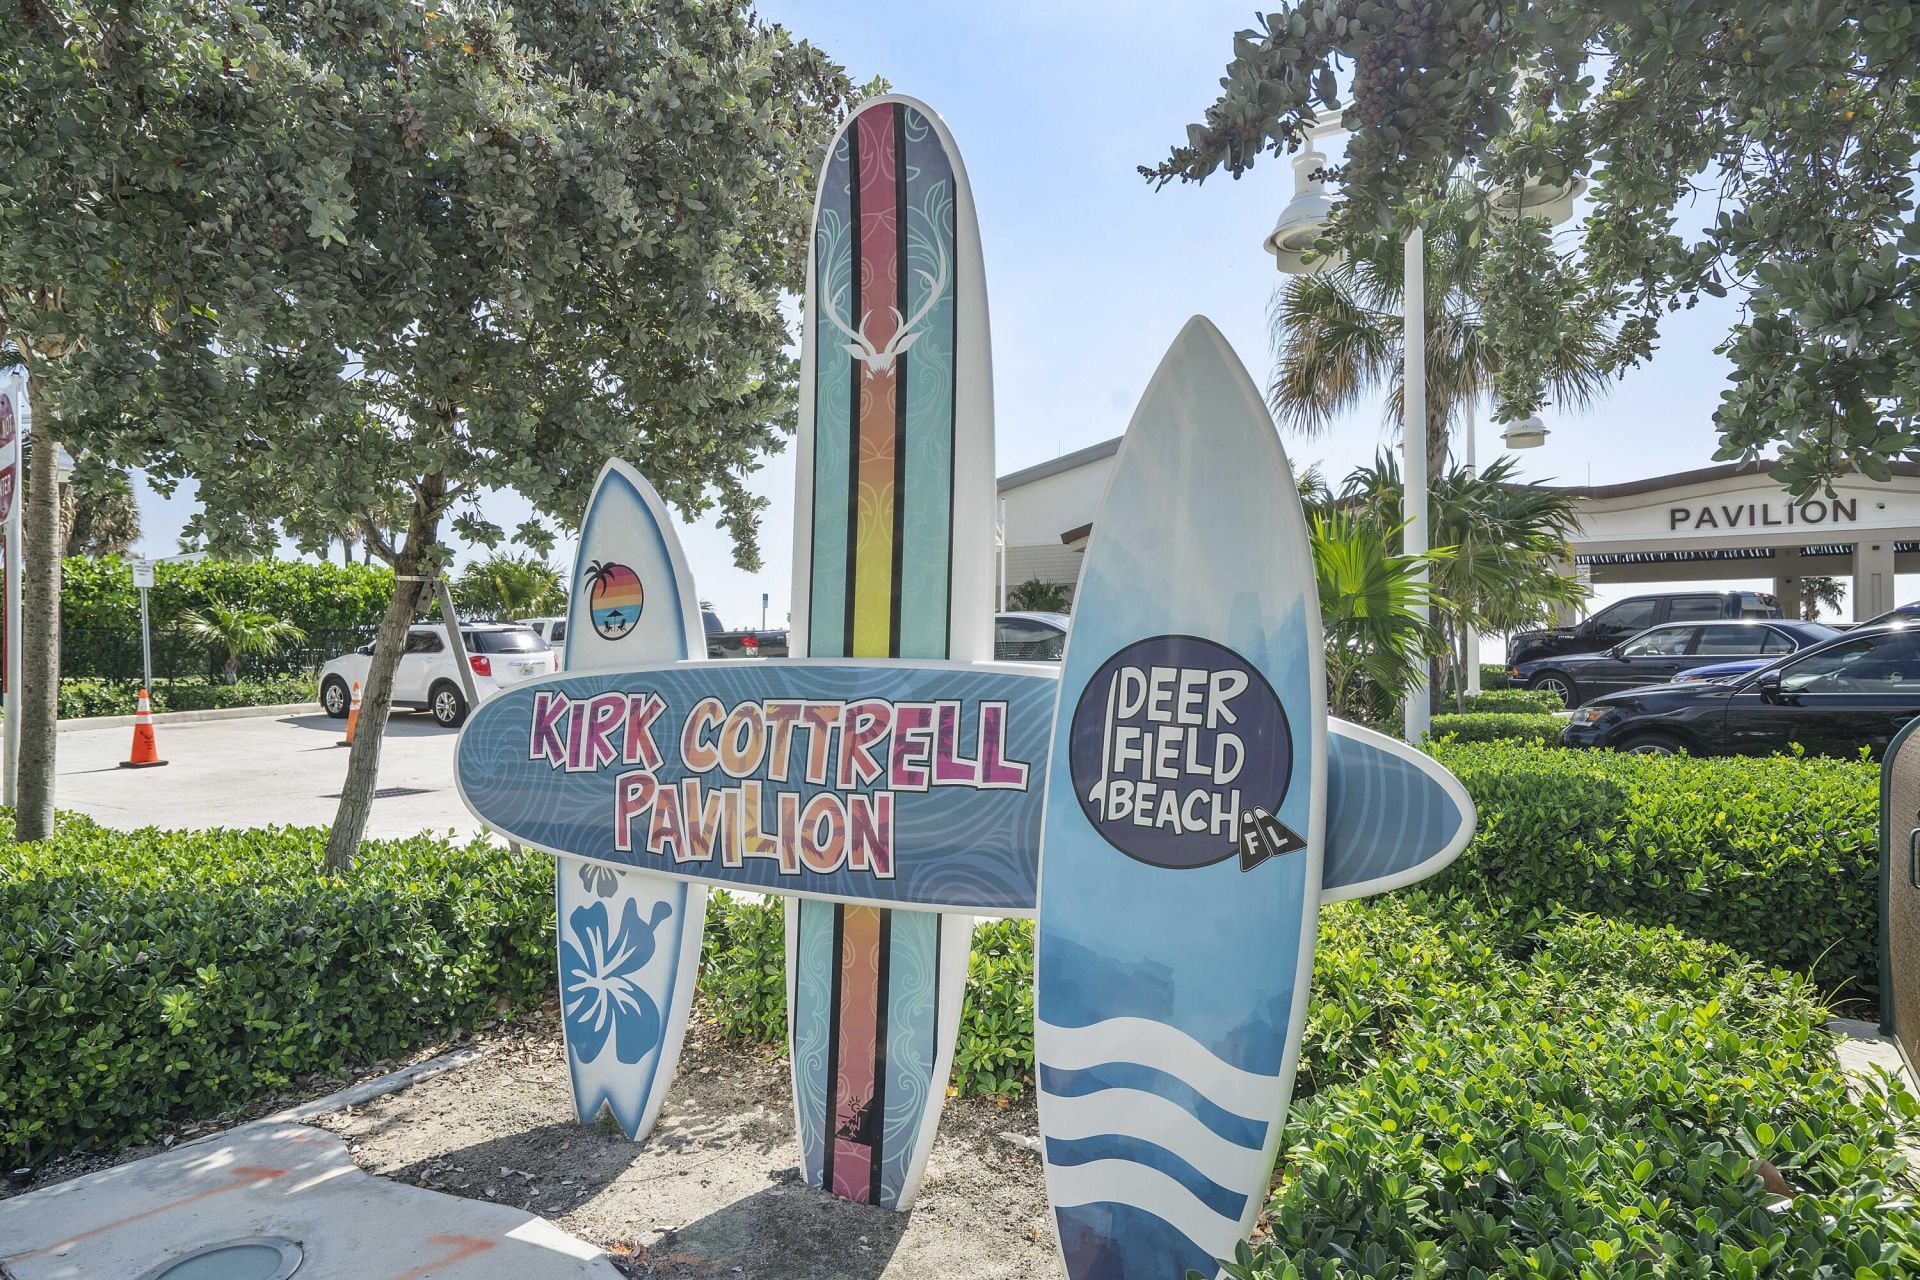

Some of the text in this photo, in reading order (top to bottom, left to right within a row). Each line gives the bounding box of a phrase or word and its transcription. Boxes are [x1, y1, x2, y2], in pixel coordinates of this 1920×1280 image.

[1670, 498, 1857, 531] PAVILION
[1117, 666, 1250, 729] DEER
[530, 691, 1031, 792] KIRK COTTRELL
[1113, 725, 1246, 785] FIELD
[614, 769, 896, 880] PAVILION
[1107, 780, 1241, 843] BEACH
[1244, 825, 1289, 855] FL
